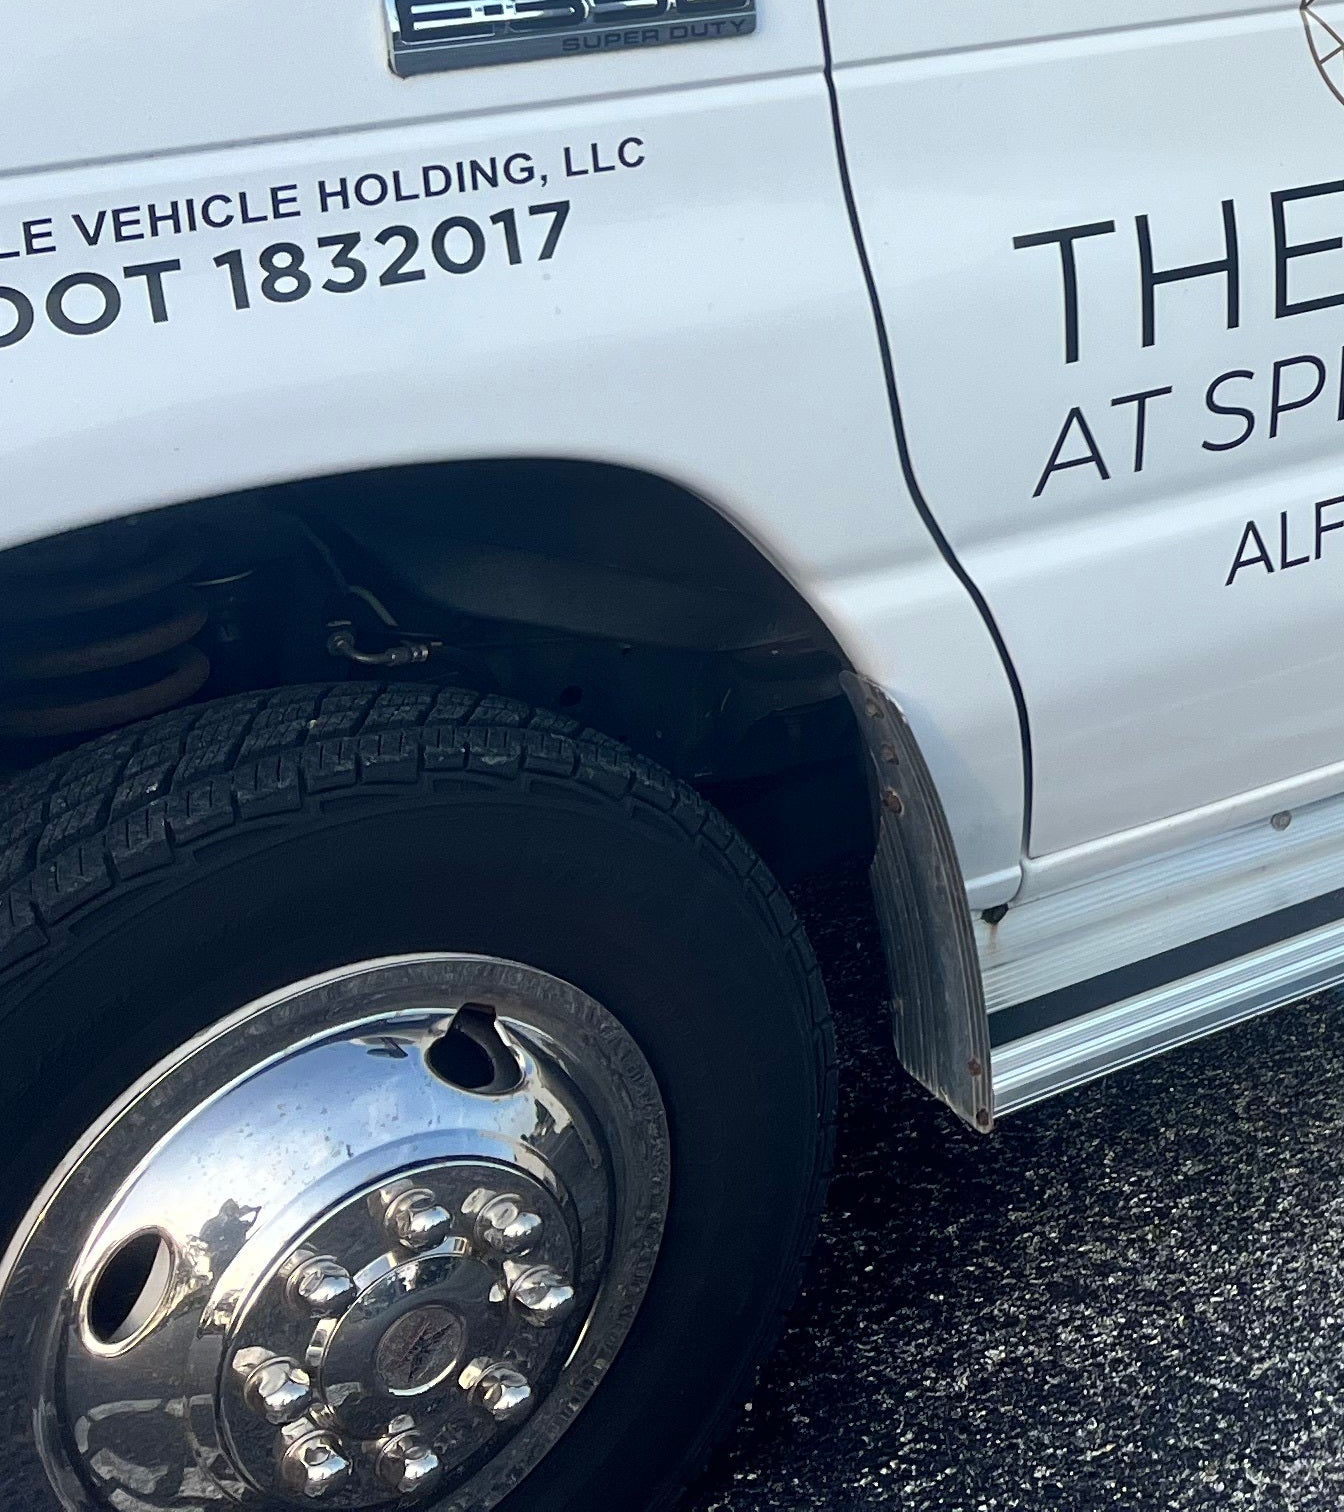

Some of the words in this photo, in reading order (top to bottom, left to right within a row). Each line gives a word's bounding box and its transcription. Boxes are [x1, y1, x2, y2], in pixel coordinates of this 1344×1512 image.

[561, 28, 660, 53] SUPER
[669, 18, 746, 41] DUTY
[72, 184, 302, 247] VEHICLE
[317, 152, 549, 213] HOLDING,
[564, 136, 646, 178] LLC
[212, 200, 572, 310] 1832017
[1032, 386, 1172, 497] AT
